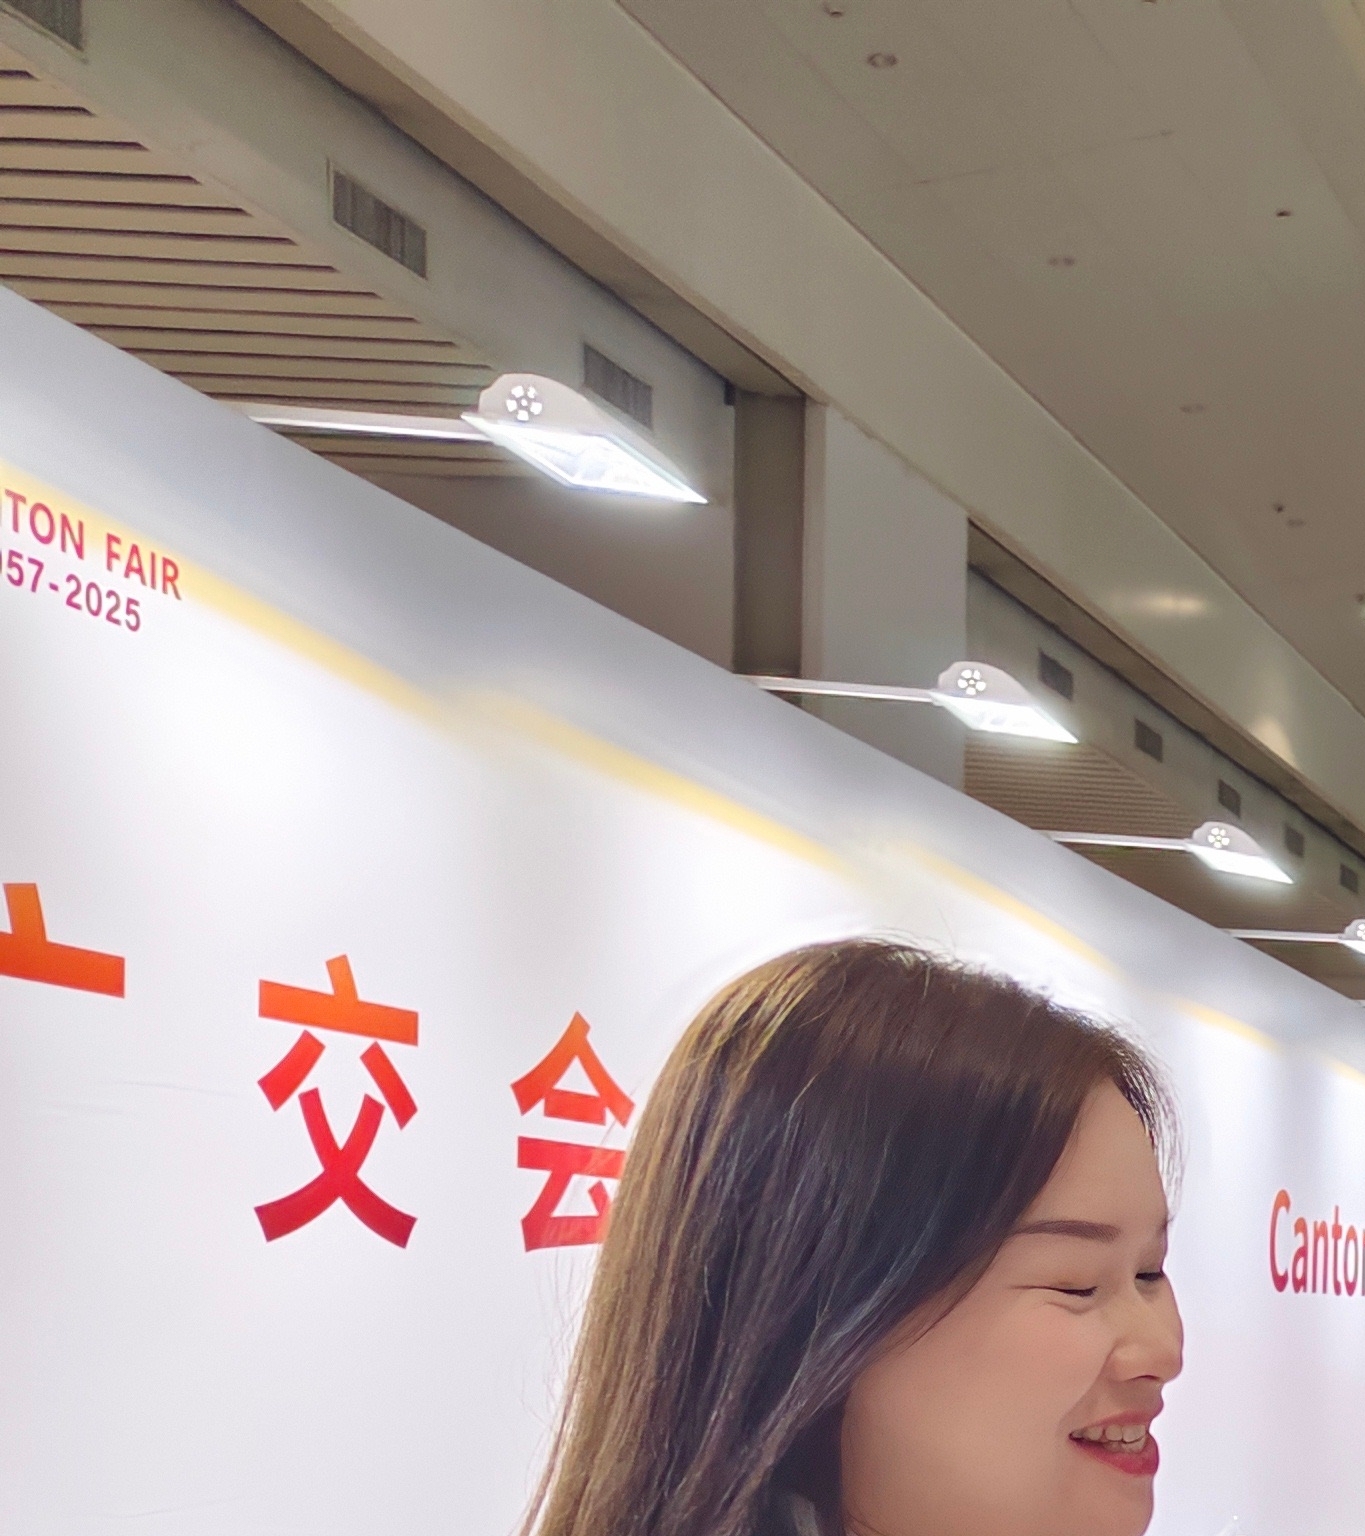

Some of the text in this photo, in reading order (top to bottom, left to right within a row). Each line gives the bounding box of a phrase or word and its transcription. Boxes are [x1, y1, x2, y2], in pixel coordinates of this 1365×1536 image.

[0, 488, 182, 601] TON FAIR
[0, 548, 141, 632] 57-2025
